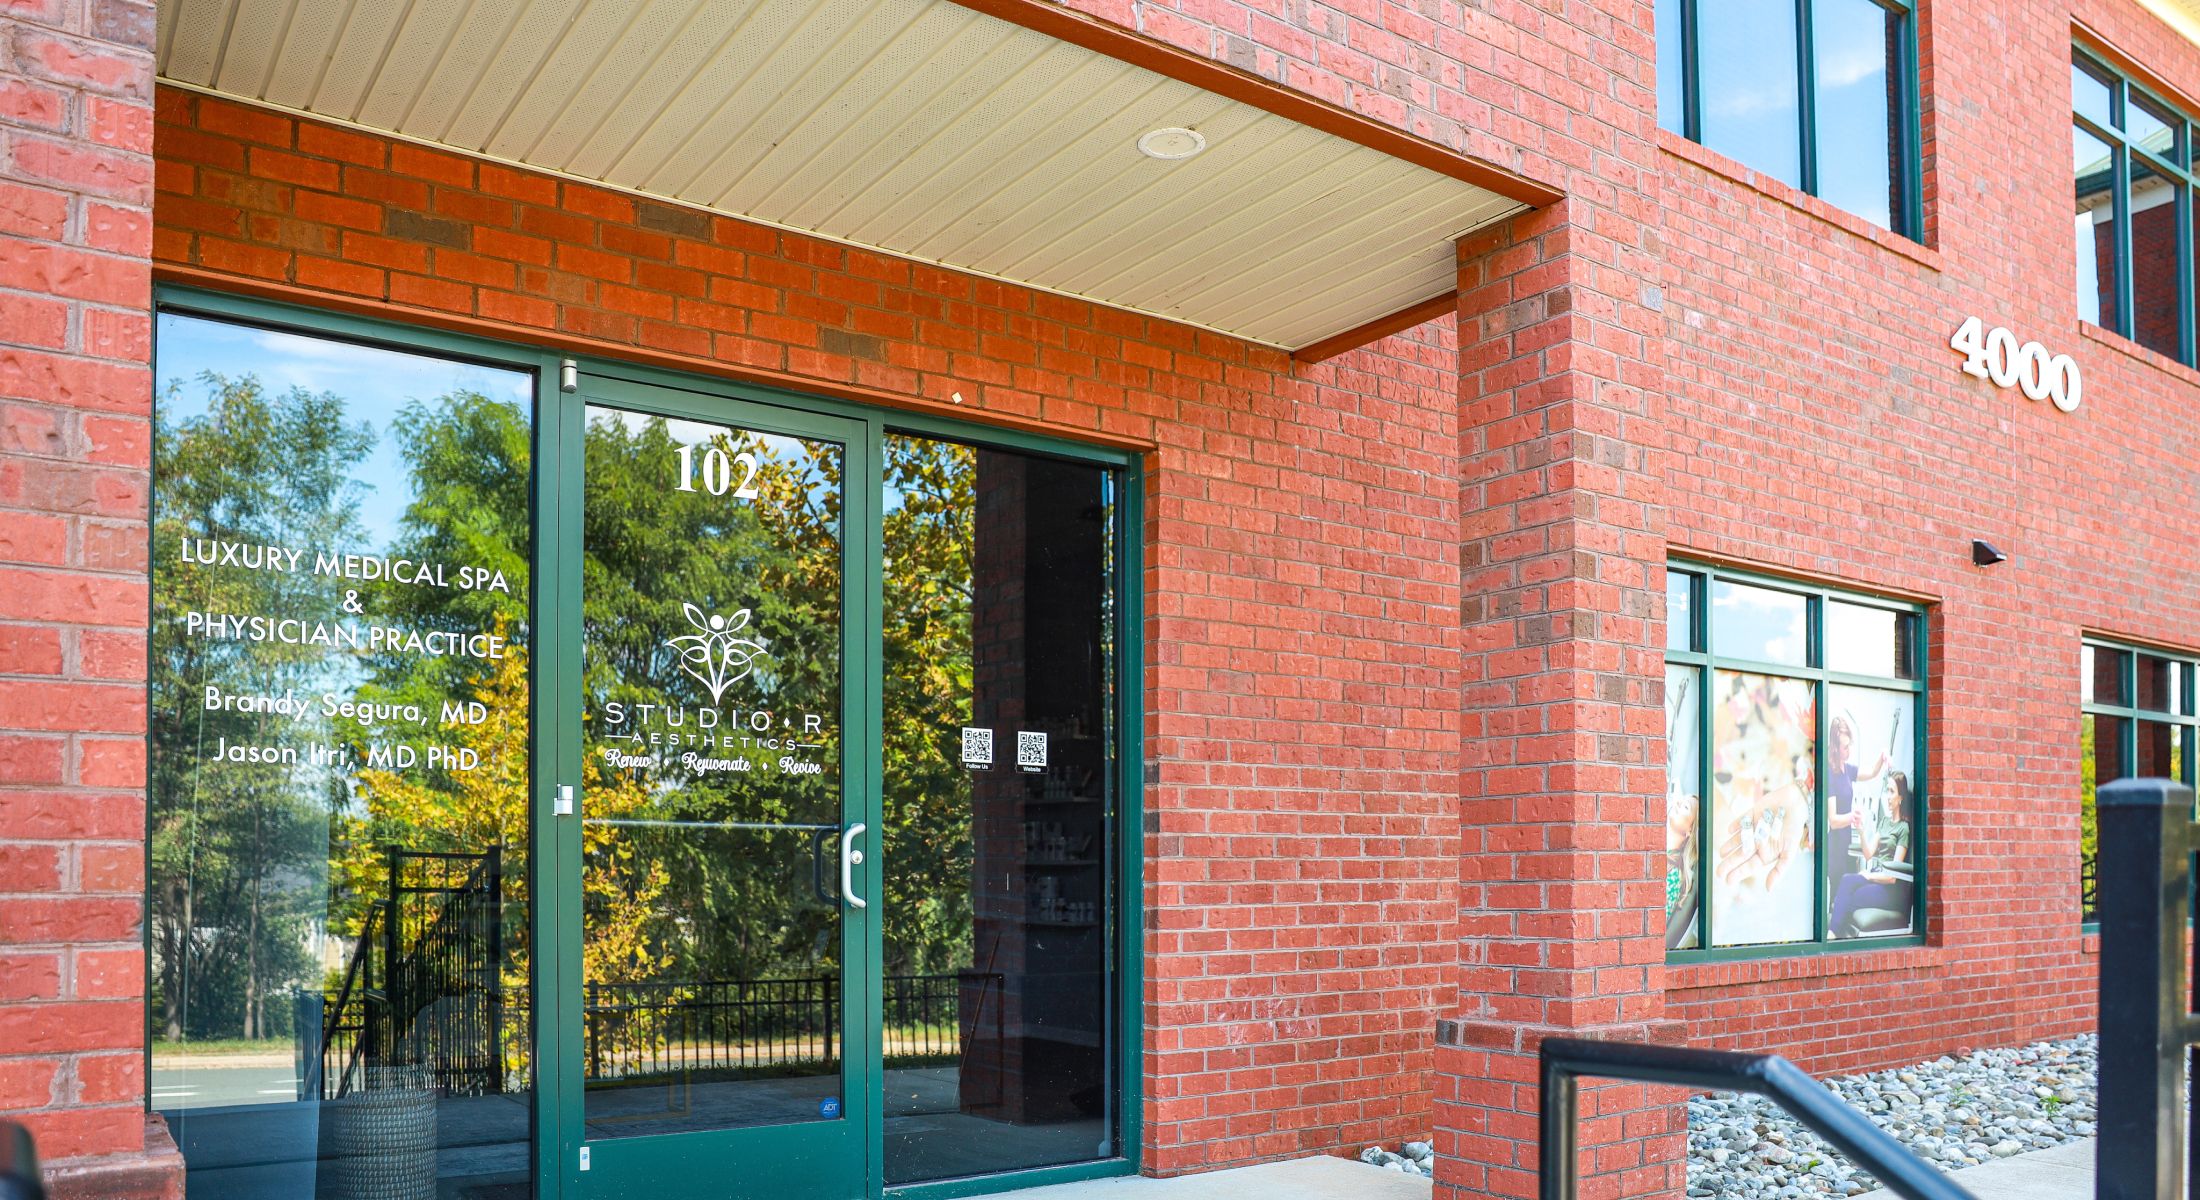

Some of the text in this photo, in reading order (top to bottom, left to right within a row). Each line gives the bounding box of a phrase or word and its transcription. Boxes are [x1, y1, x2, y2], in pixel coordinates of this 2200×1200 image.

[1950, 316, 2082, 412] 4000
[673, 445, 760, 500] 102
[181, 537, 510, 593] LUXURY MEDICAL SPA
[342, 589, 364, 615] &
[187, 611, 504, 659] PHYSICIAN PRACTICE
[205, 686, 487, 727] Brandy Segura, MD
[605, 702, 771, 731] STUDIO
[212, 737, 478, 772] Jason Itri, MD PhD
[631, 732, 797, 751] AESTHETICS
[604, 748, 822, 777] Renew Rejuvenate Revive
[823, 1103, 837, 1111] ADT
